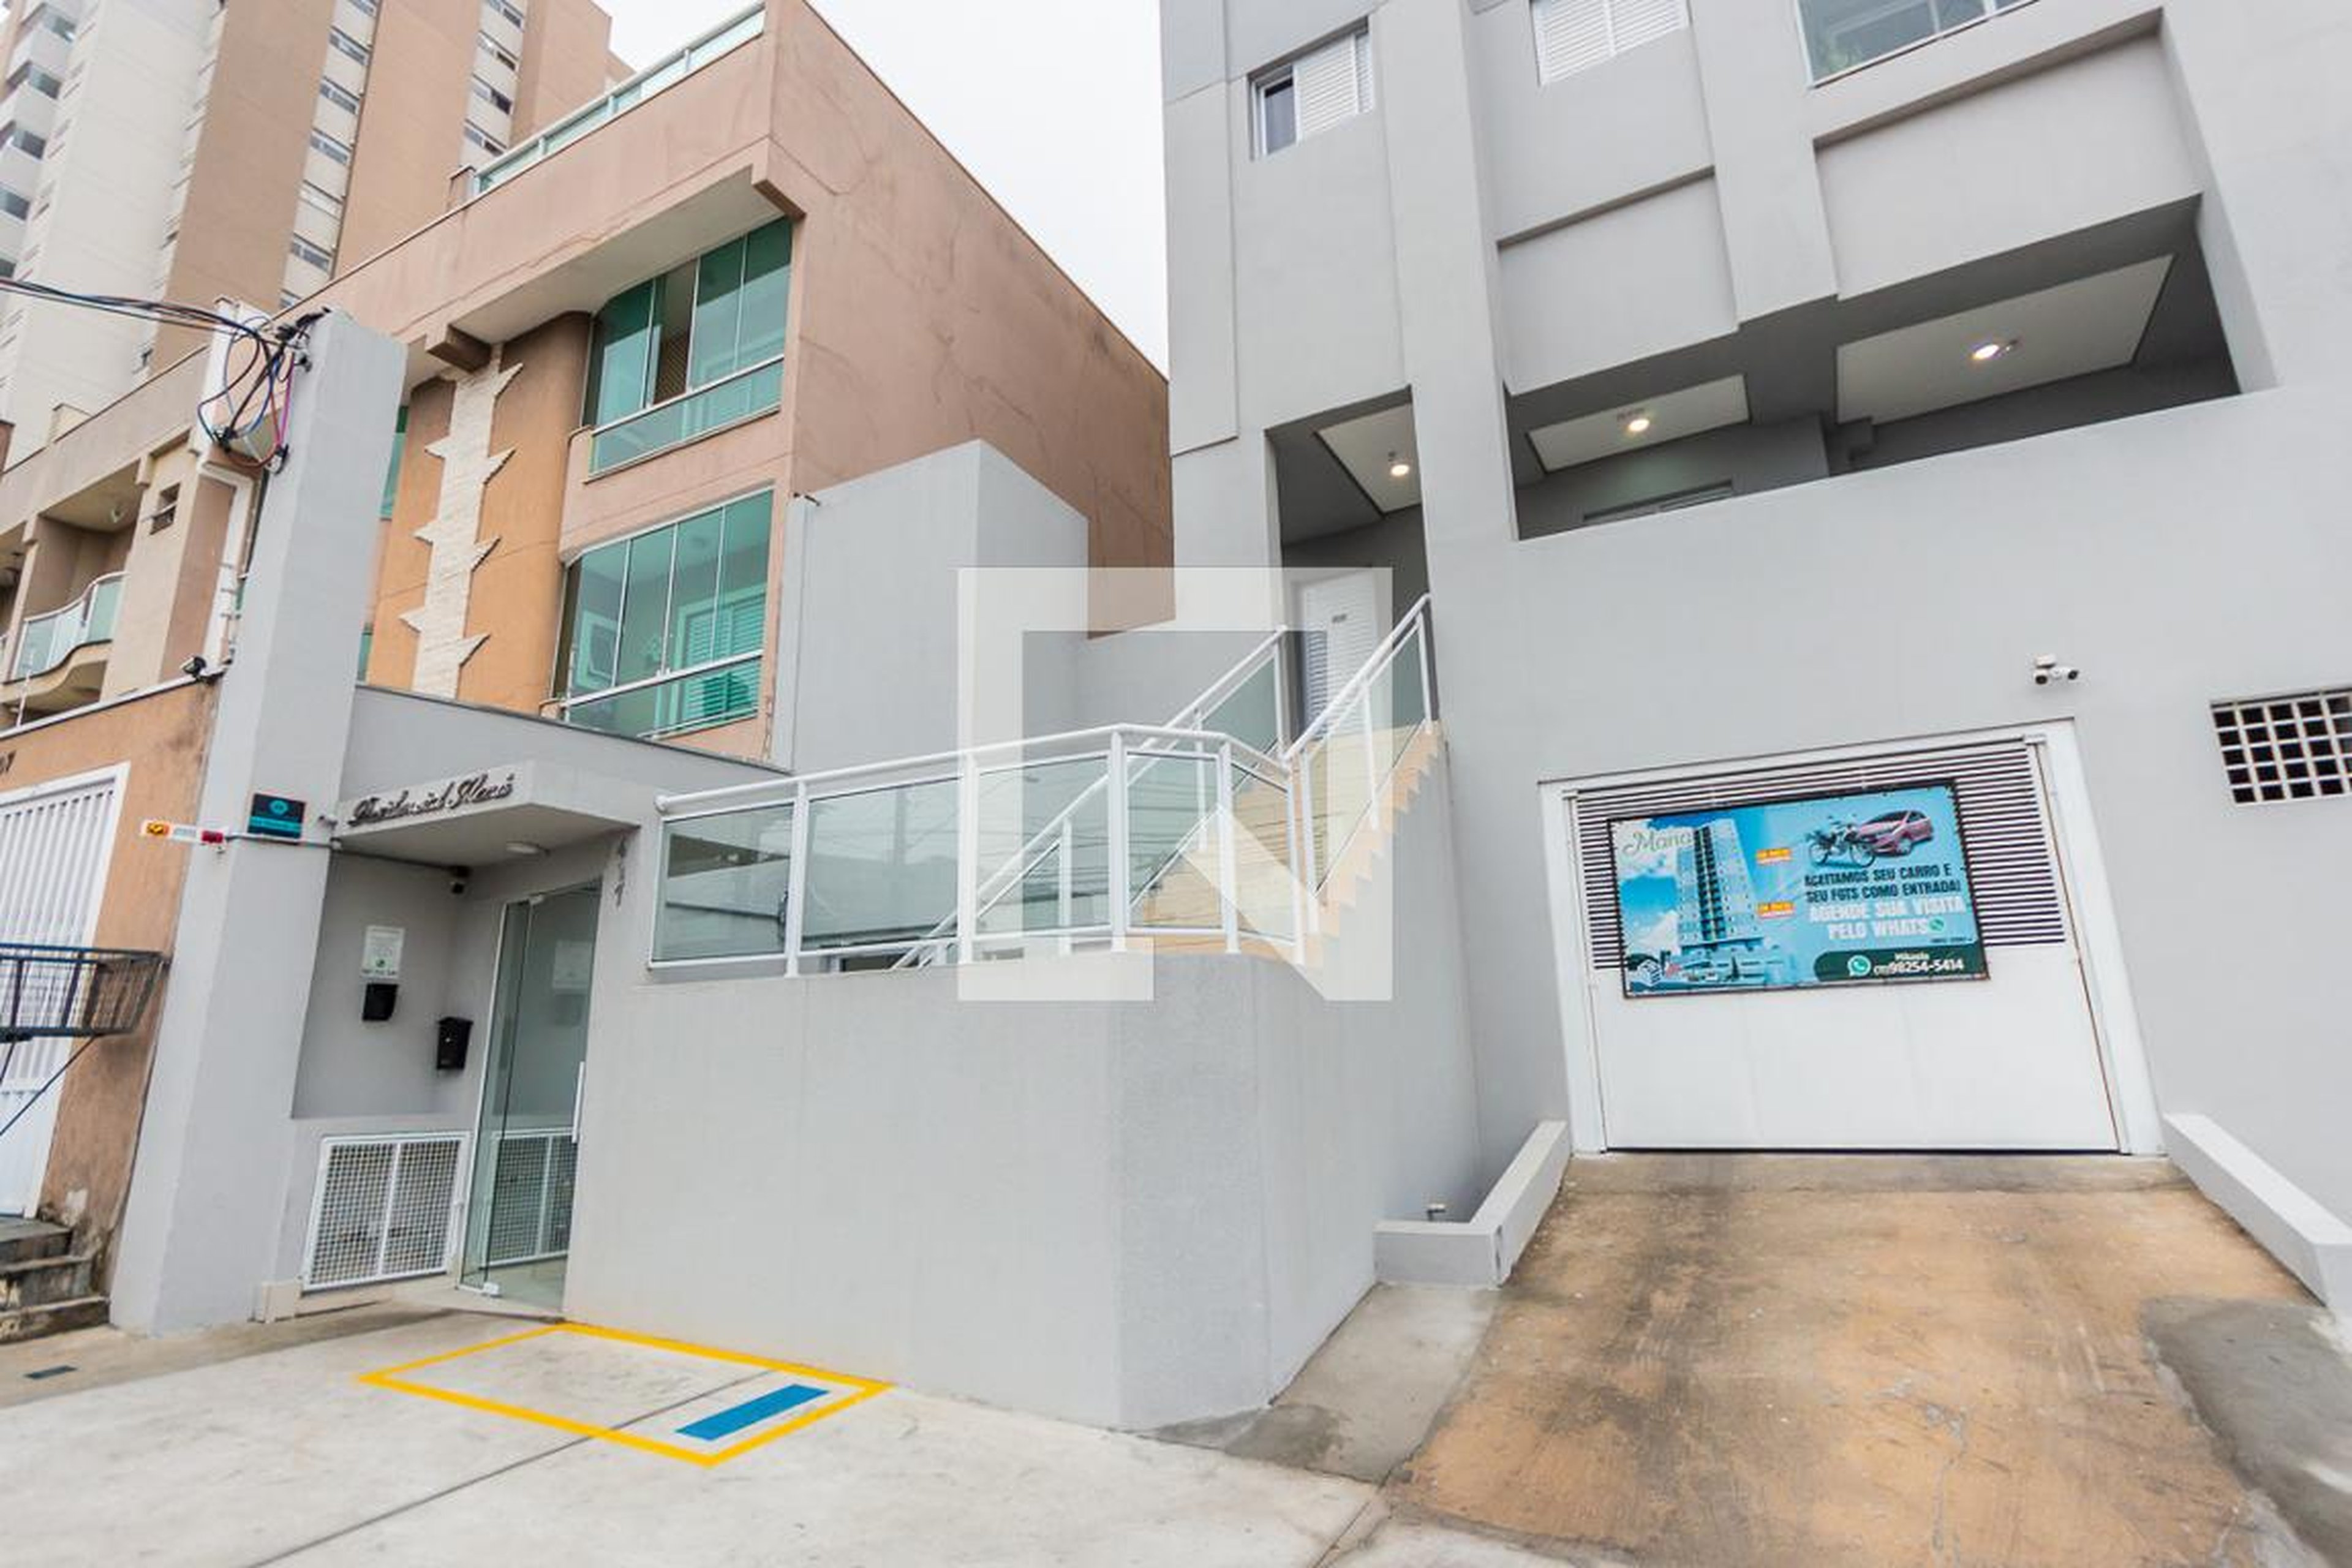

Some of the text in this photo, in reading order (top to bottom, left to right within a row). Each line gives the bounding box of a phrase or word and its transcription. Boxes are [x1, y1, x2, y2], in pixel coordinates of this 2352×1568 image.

[1873, 868, 1896, 882] SEU
[1900, 865, 1940, 879] CARRO
[1943, 863, 1952, 876] E
[1806, 889, 1828, 903] SEU
[1861, 884, 1897, 899] COMO
